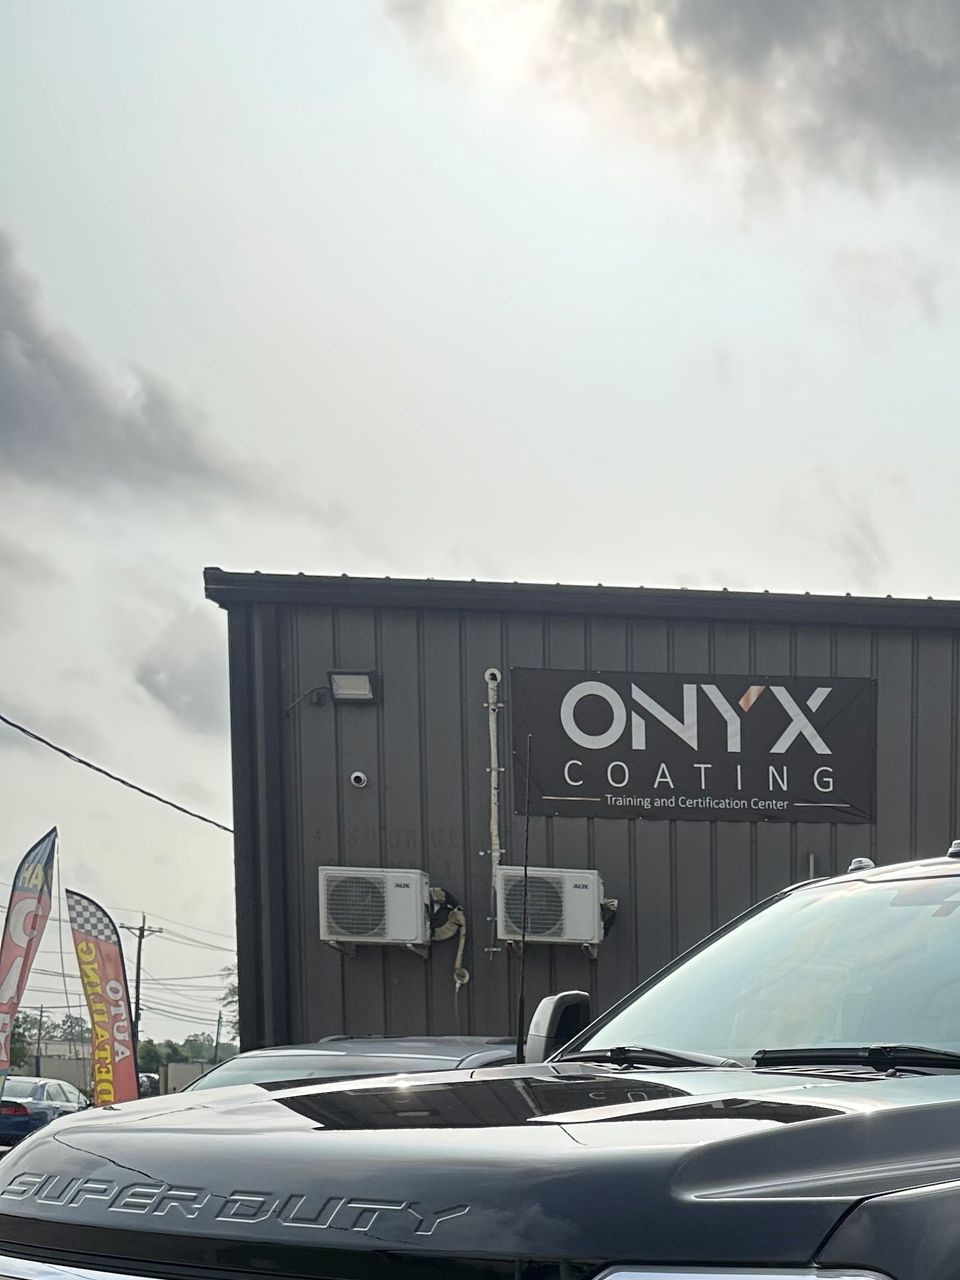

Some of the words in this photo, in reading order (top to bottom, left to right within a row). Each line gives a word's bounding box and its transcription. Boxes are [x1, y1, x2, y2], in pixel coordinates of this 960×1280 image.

[560, 680, 833, 755] ONYX
[563, 759, 835, 793] COATING
[605, 794, 651, 809] Training
[653, 796, 676, 808] and
[678, 796, 748, 809] Certification
[750, 798, 790, 810] Center
[1, 1171, 211, 1219] SUPER
[215, 1189, 471, 1236] DUTY
